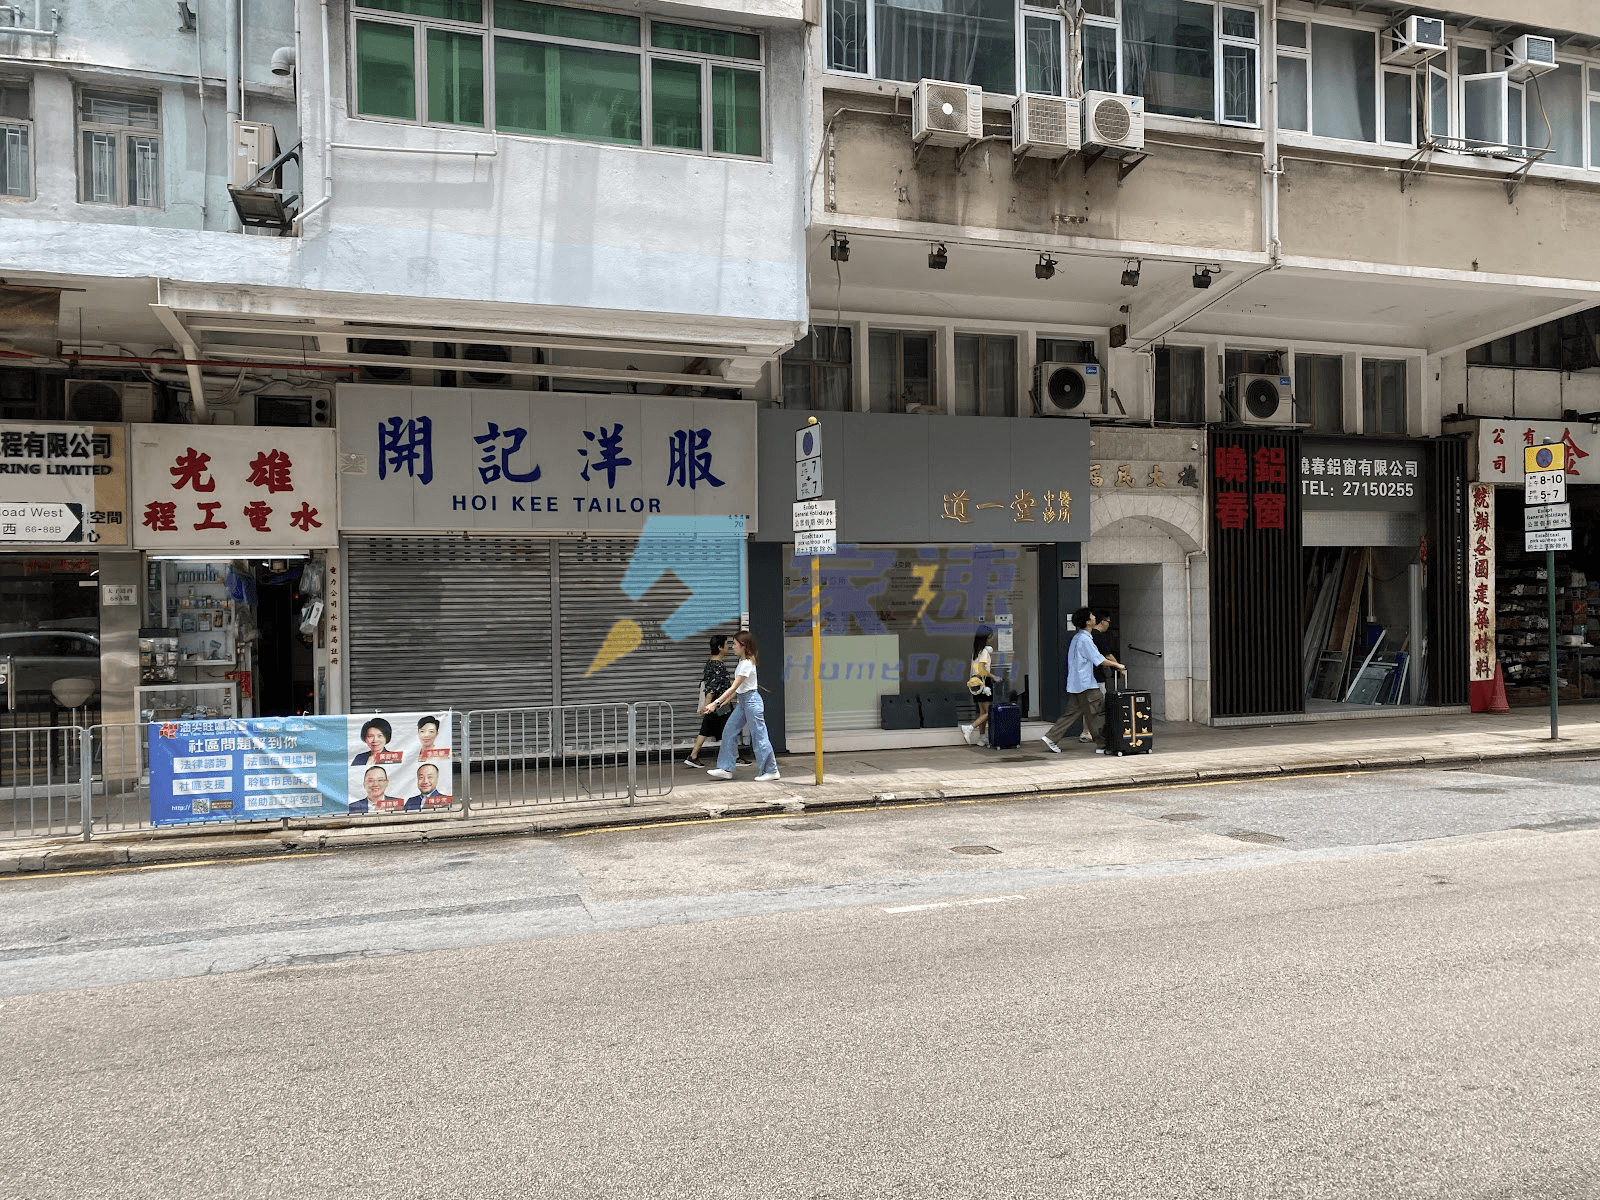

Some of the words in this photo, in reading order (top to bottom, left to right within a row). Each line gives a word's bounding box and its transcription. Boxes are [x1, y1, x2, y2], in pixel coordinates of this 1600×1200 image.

[378, 415, 725, 489] 開記洋服
[46, 464, 113, 476] LIMITED
[1540, 474, 1563, 485] 8-10
[1301, 480, 1335, 496] TEL:
[1342, 482, 1414, 497] 27150255
[452, 494, 498, 511] HOI
[511, 495, 559, 512] KEE
[573, 496, 662, 513] TAILOR
[941, 489, 1038, 523] 道一堂
[0, 508, 26, 517] oad
[30, 507, 64, 518] West
[81, 510, 122, 525] 空間
[25, 525, 62, 534] 66-88B
